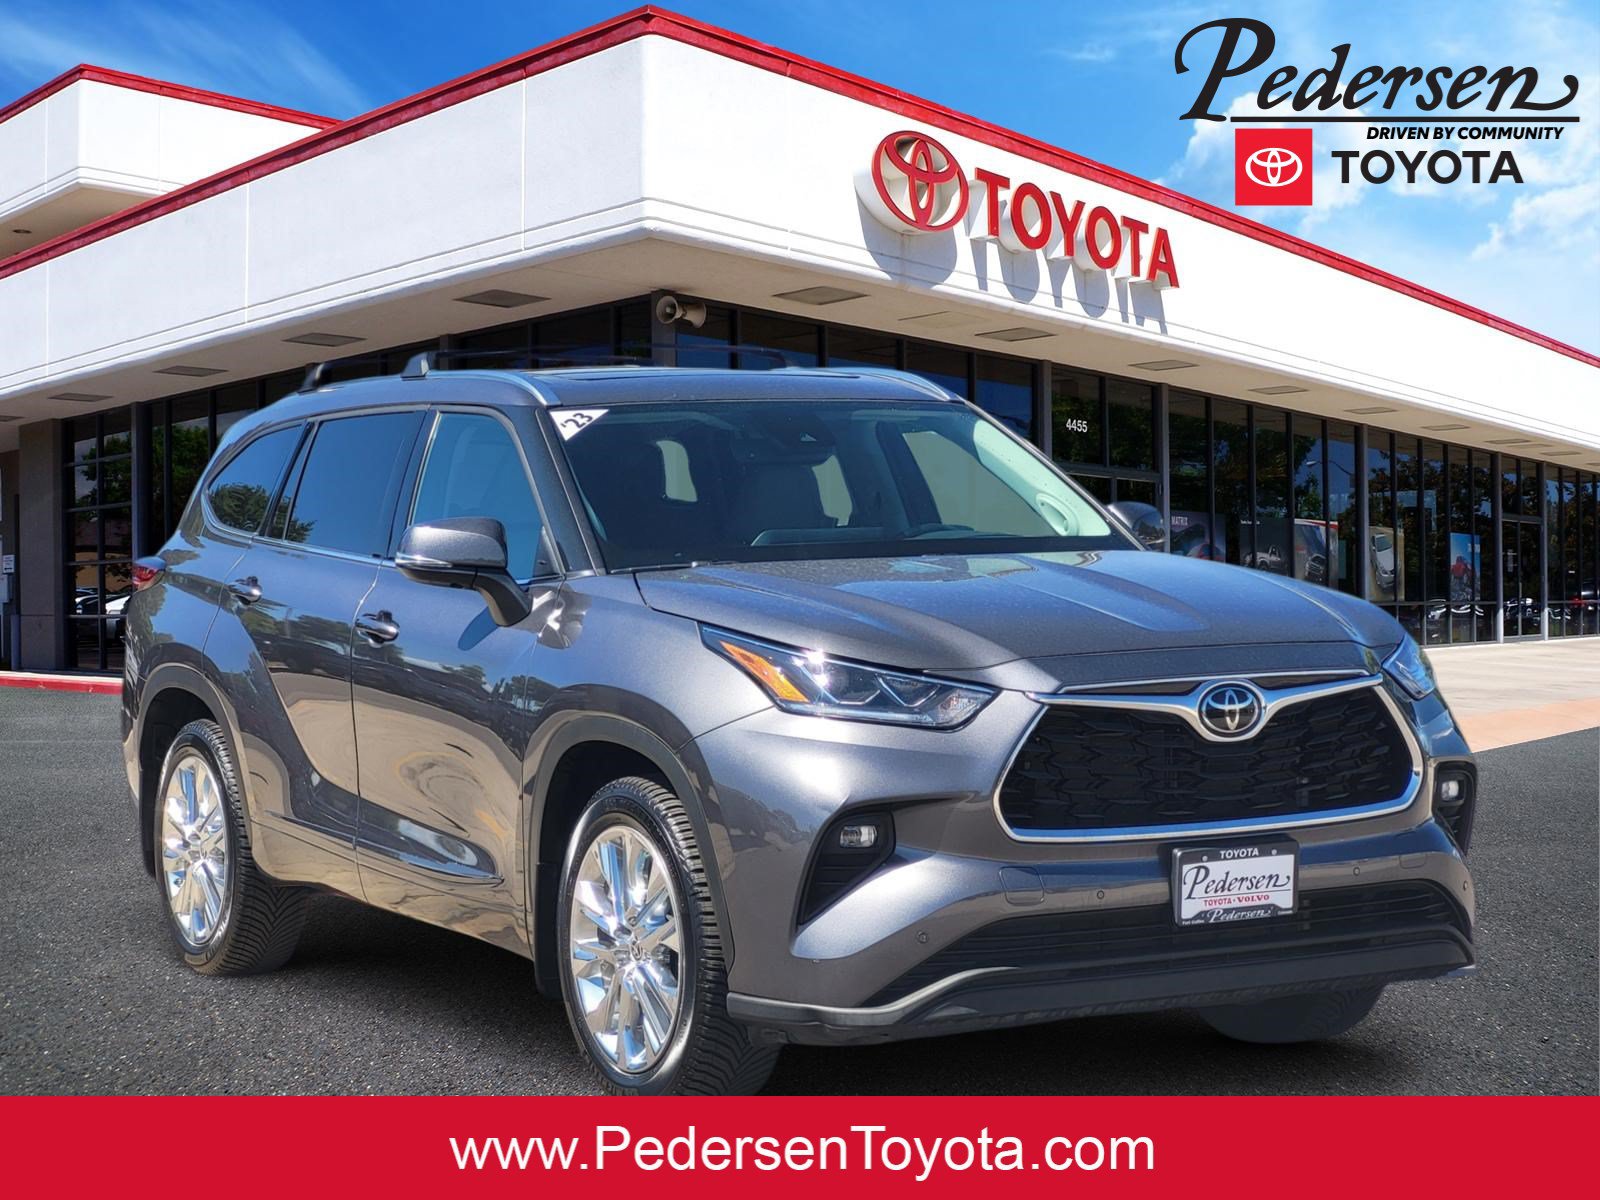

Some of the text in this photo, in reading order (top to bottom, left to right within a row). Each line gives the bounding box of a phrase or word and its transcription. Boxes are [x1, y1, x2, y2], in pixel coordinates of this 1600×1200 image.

[974, 167, 1180, 289] TOYOTA
[1065, 418, 1088, 433] 4455
[1219, 848, 1260, 860] TOYOTA
[1183, 865, 1291, 900] Pedersen
[1204, 894, 1270, 907] TOYOTA VOLVO
[1206, 907, 1273, 923] Pedersen
